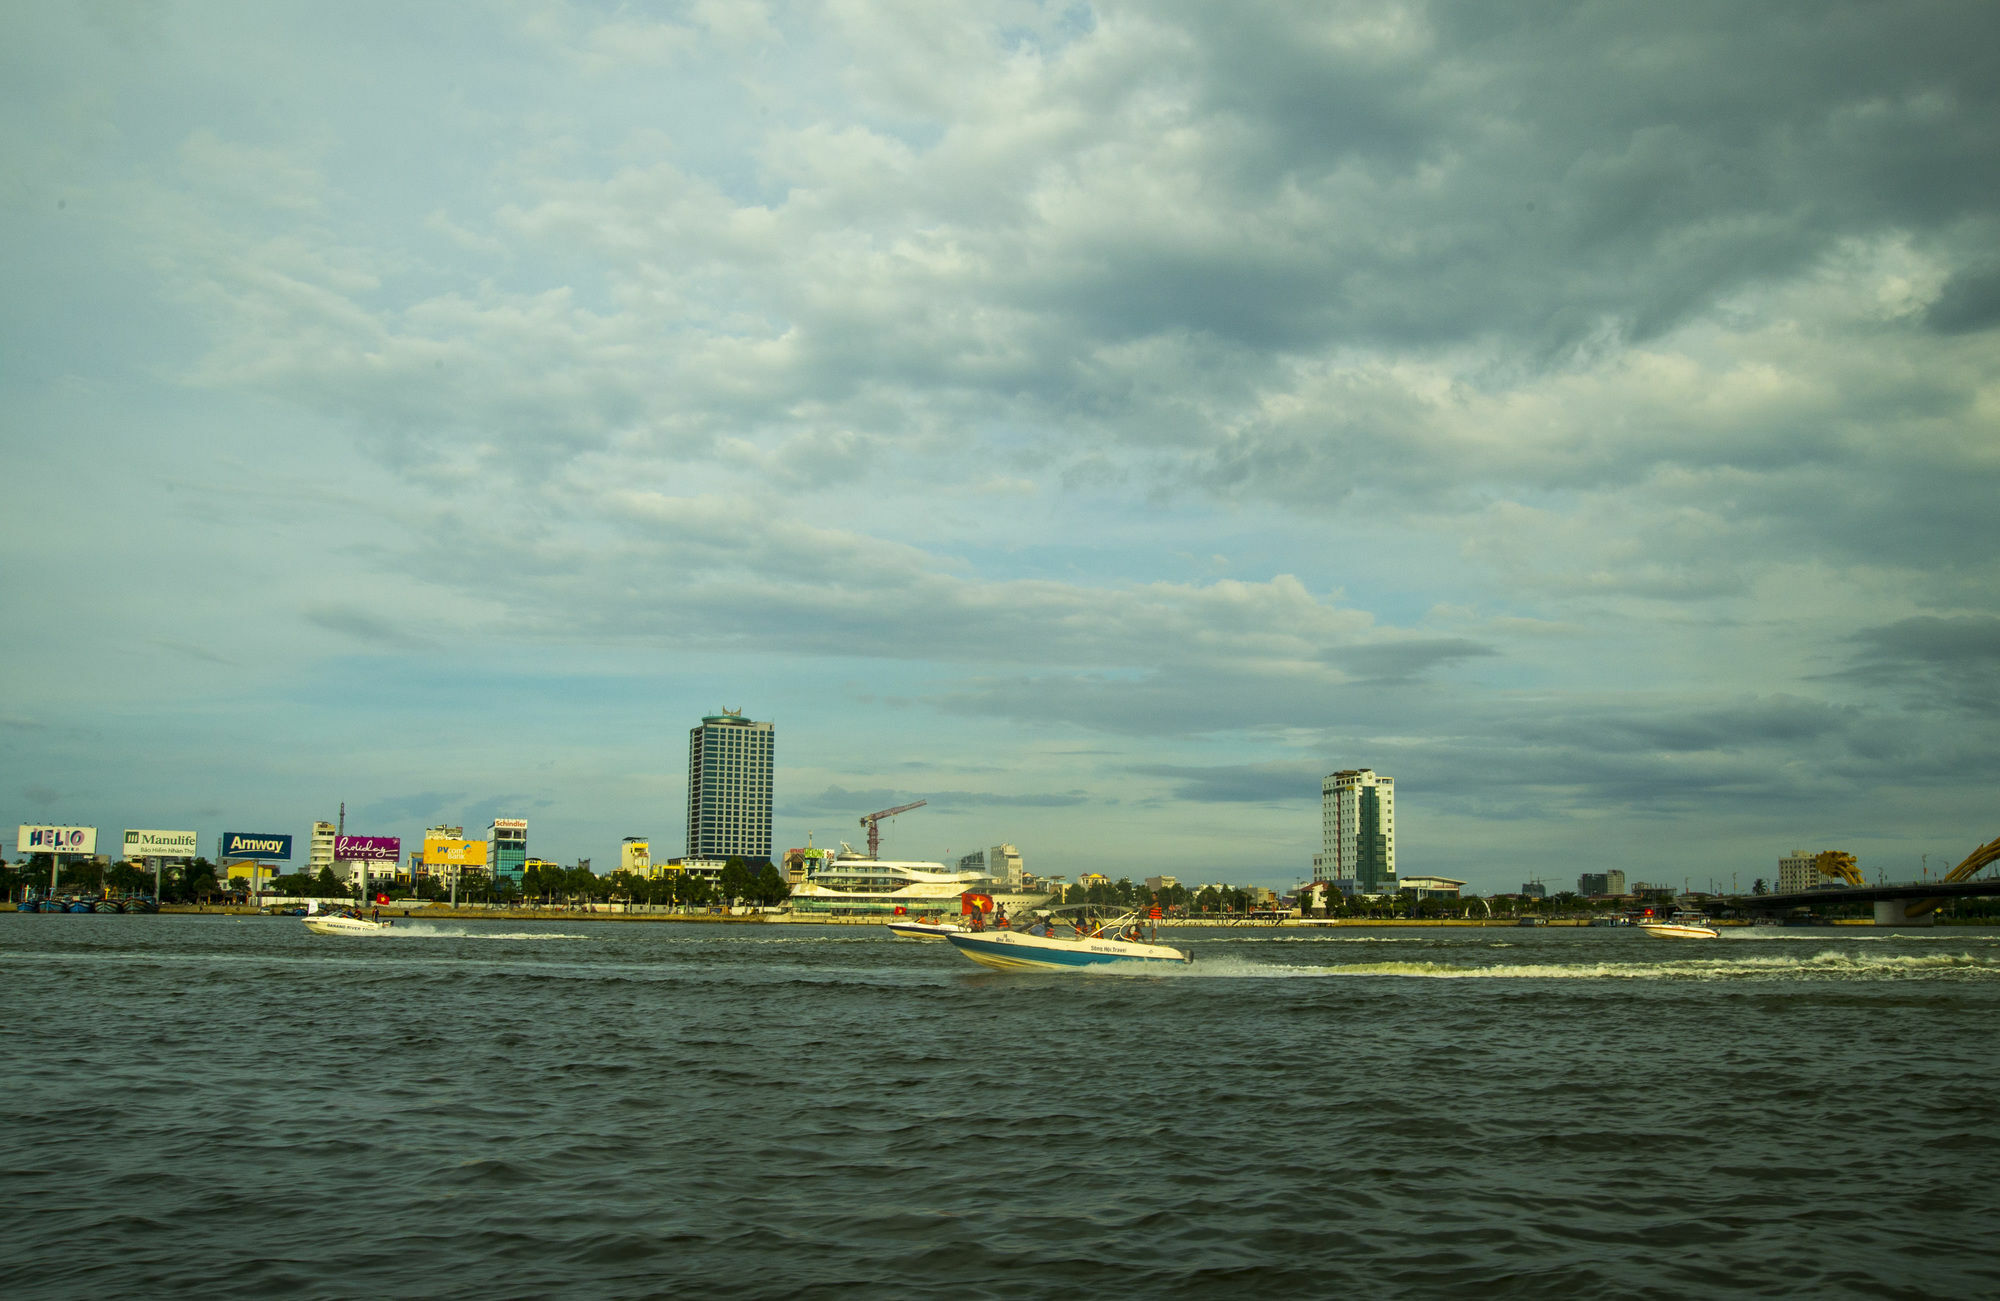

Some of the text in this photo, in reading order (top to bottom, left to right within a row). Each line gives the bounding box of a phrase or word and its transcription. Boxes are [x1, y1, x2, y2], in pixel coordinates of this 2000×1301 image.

[30, 828, 85, 848] HELIO
[141, 834, 196, 846] Manulife
[230, 835, 284, 853] Amway
[335, 836, 398, 858] holiday
